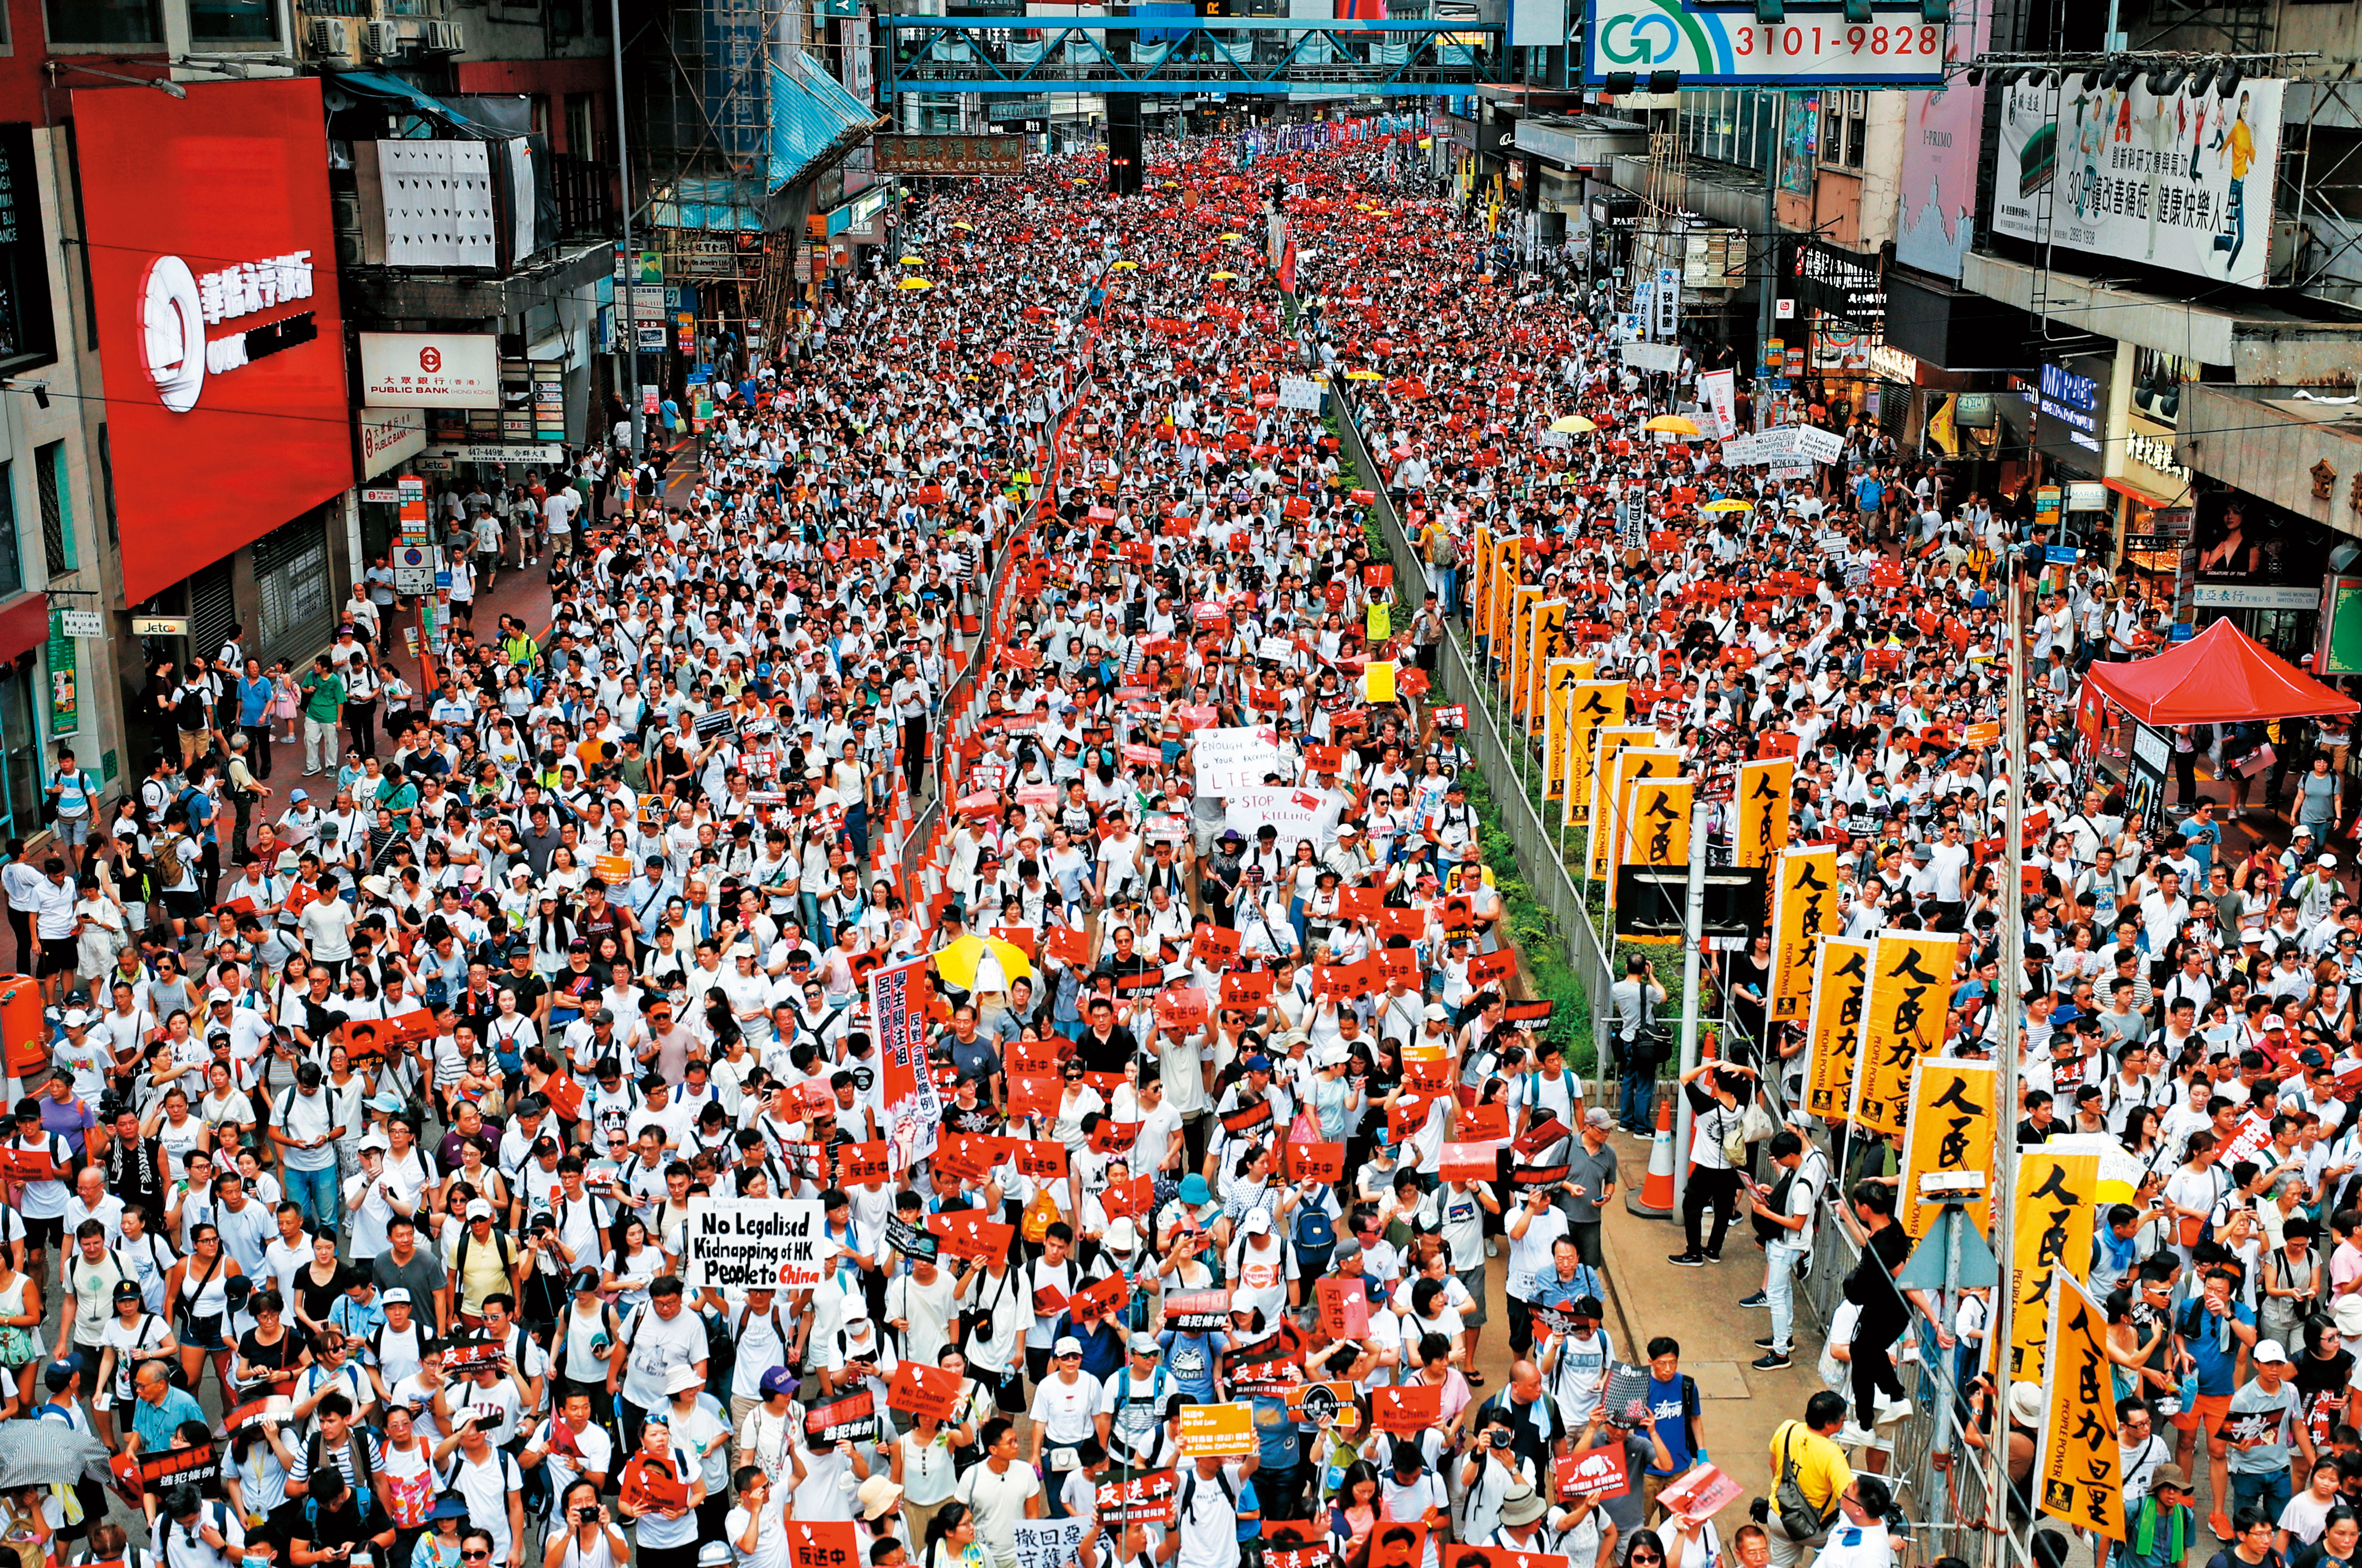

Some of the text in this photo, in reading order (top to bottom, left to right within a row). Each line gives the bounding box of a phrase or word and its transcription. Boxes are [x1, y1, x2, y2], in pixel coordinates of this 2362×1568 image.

[1736, 26, 1937, 56] 3101-9828
[2112, 146, 2188, 178] 創新科研艾療與氣功
[2067, 170, 2240, 236] 30分鐘改善痛症 健康快樂人生
[2070, 227, 2081, 242] 2893
[2083, 230, 2095, 245] 1938
[374, 429, 407, 453] PUBLIC BANK
[1764, 433, 1796, 443] LEGALISED
[1799, 438, 1823, 453] Kidnapping
[1815, 436, 1836, 450] Legalised
[467, 448, 548, 458] 447-449號 合群大廈
[1800, 447, 1817, 458] People
[1823, 455, 1835, 463] China
[421, 460, 448, 470] Jetco
[422, 583, 433, 592] 12
[144, 622, 175, 632] Jetco
[1202, 740, 1244, 753] ENOUGH
[1214, 753, 1275, 764] YOUR FXCKING
[1242, 794, 1274, 808] STOP
[1262, 812, 1312, 822] KILLING
[1201, 942, 1231, 955] 反送中
[1379, 965, 1409, 979] 反送中
[1783, 944, 1793, 995] PEOPLE POWER
[1320, 981, 1351, 996] 反送中
[1227, 990, 1262, 1004] 反送中
[892, 968, 908, 1068] 學生關注組
[1166, 1007, 1198, 1019] 反送中
[1014, 1058, 1048, 1072] 反送中
[1868, 1036, 1881, 1095] PEOPLE POWER
[1817, 1061, 1827, 1088] POWER
[1476, 1121, 1499, 1132] China
[851, 1161, 889, 1176] 反送中
[1023, 1159, 1056, 1172] 反送中
[1297, 1162, 1332, 1175] 反送中
[702, 1212, 809, 1239] No Legalised
[694, 1237, 812, 1265] Kidnapping of HK
[973, 1238, 997, 1252] China
[704, 1262, 819, 1286] People to China
[1082, 1293, 1119, 1318] 反送中
[1178, 1313, 1226, 1328] 逃犯條例
[1232, 1361, 1300, 1383] 反送中
[899, 1386, 945, 1403] No China
[896, 1397, 941, 1414] Extradition
[1383, 1409, 1428, 1420] No China
[823, 1420, 873, 1440] 逃犯條例
[2054, 1398, 2071, 1475] PEOPLE POWER
[160, 1466, 214, 1486] 逃犯條例
[629, 1486, 675, 1506] No China
[1097, 1478, 1172, 1506] 反送中
[799, 1547, 845, 1566] 反送中
